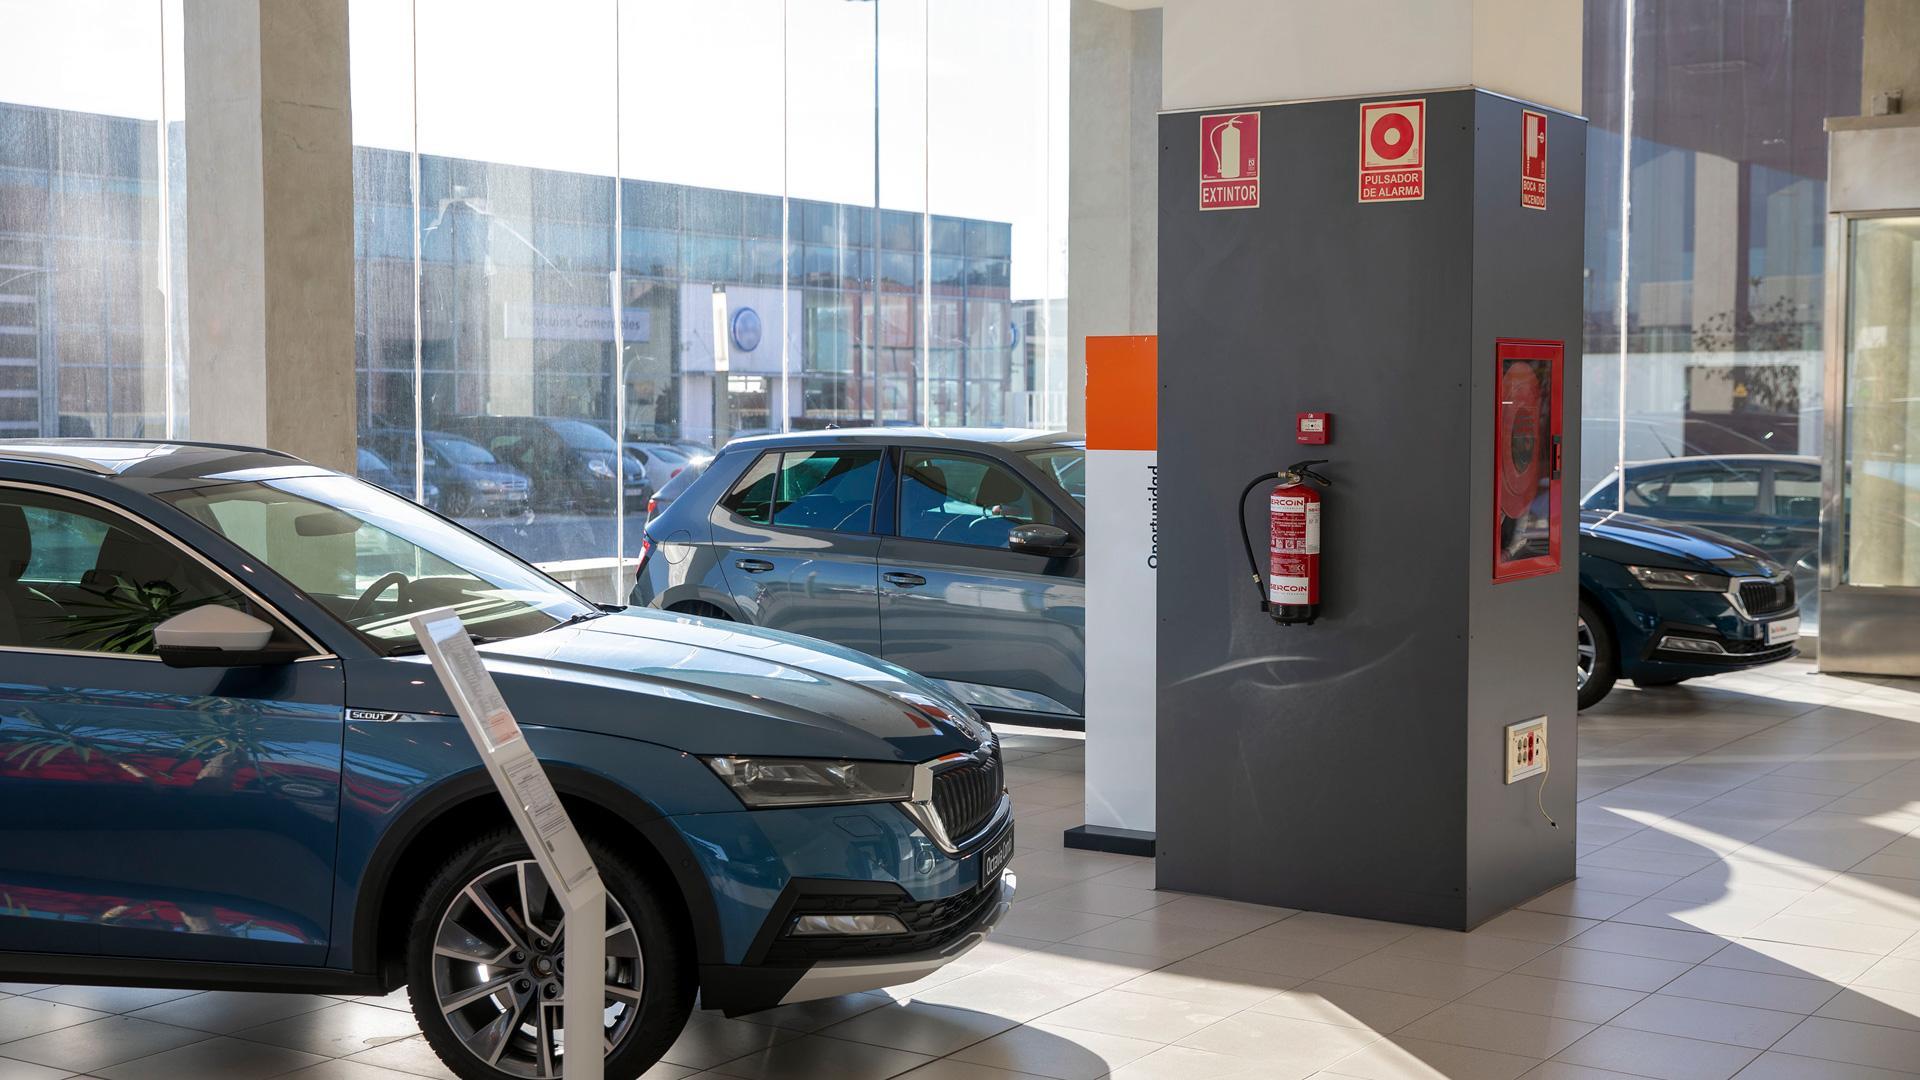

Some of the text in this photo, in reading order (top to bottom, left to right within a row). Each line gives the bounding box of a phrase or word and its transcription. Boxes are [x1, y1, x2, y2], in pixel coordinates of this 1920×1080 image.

[1365, 173, 1419, 185] PULSADOR
[1363, 186, 1420, 198] DE ALARMA
[1523, 180, 1545, 194] BOCA DE
[1202, 185, 1257, 203] EXTINTOR
[352, 711, 385, 720] SCOUT
